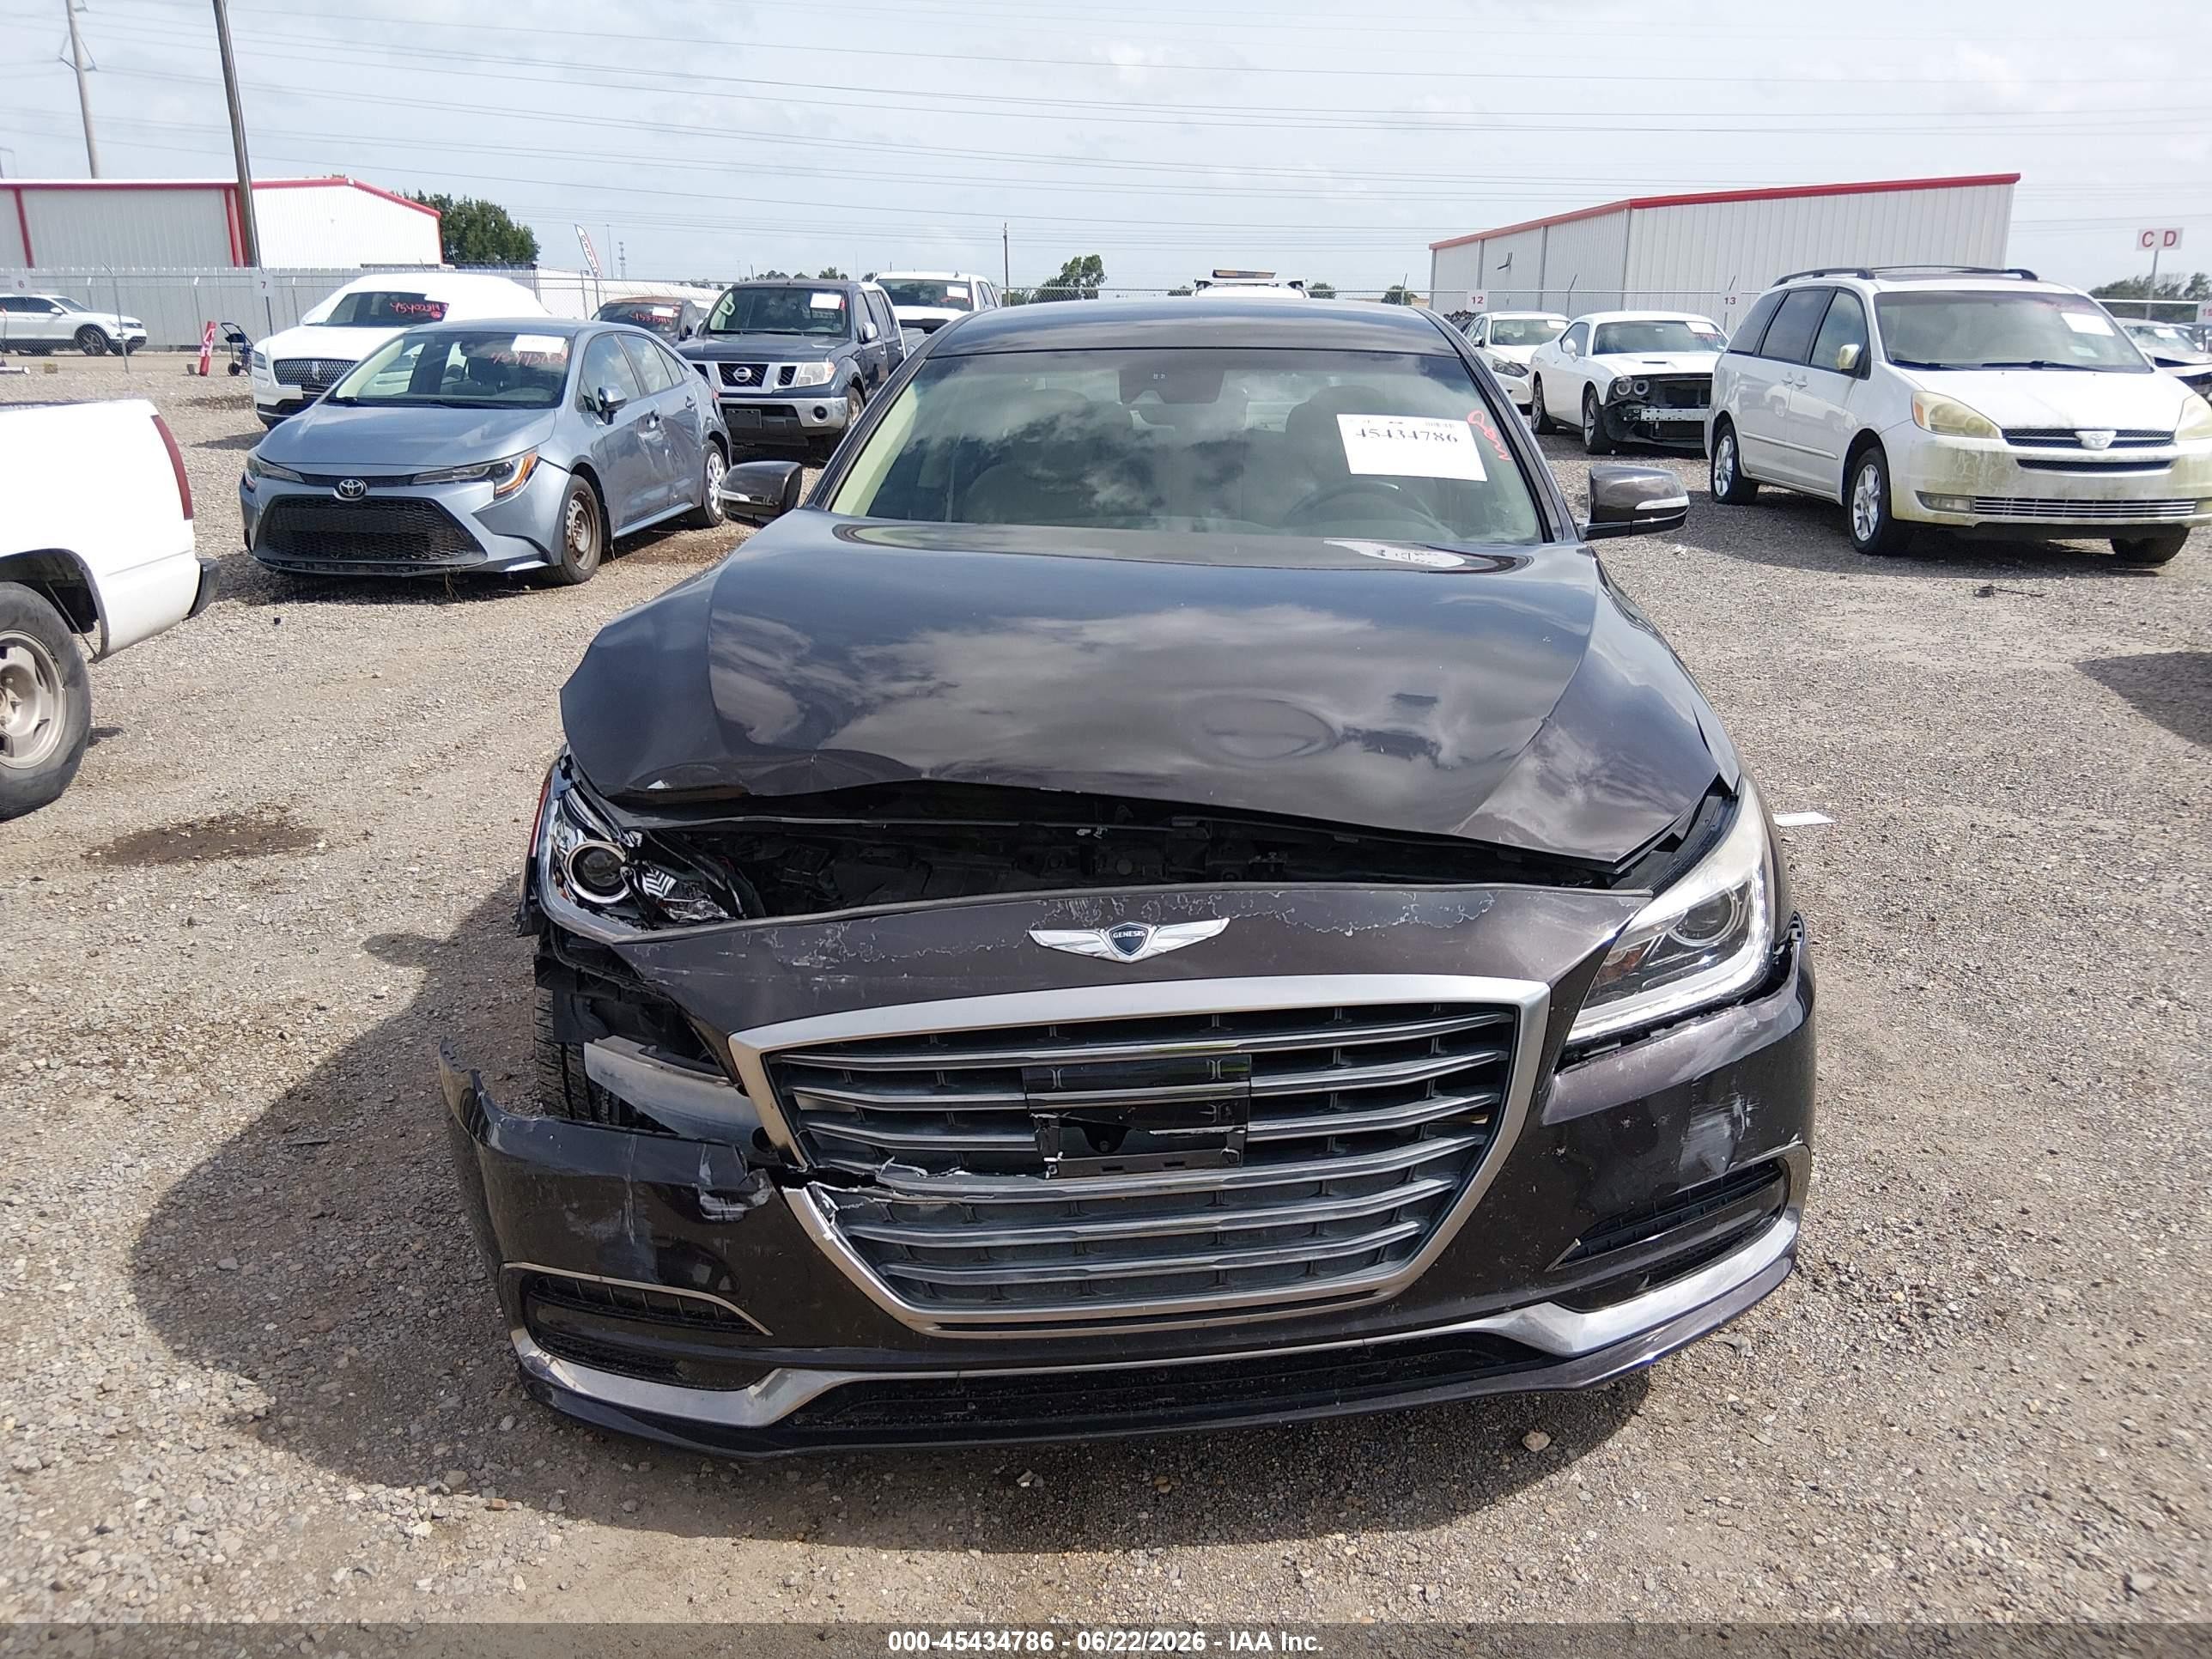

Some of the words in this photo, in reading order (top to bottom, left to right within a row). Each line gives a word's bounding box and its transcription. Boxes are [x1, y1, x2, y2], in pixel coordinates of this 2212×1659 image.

[2142, 231, 2154, 247] C
[2163, 230, 2177, 246] D
[18, 280, 25, 289] 6
[1471, 295, 1484, 304] 12
[1724, 296, 1736, 305] 13
[1355, 428, 1458, 443] 45434786
[1112, 930, 1146, 939] GENESIS
